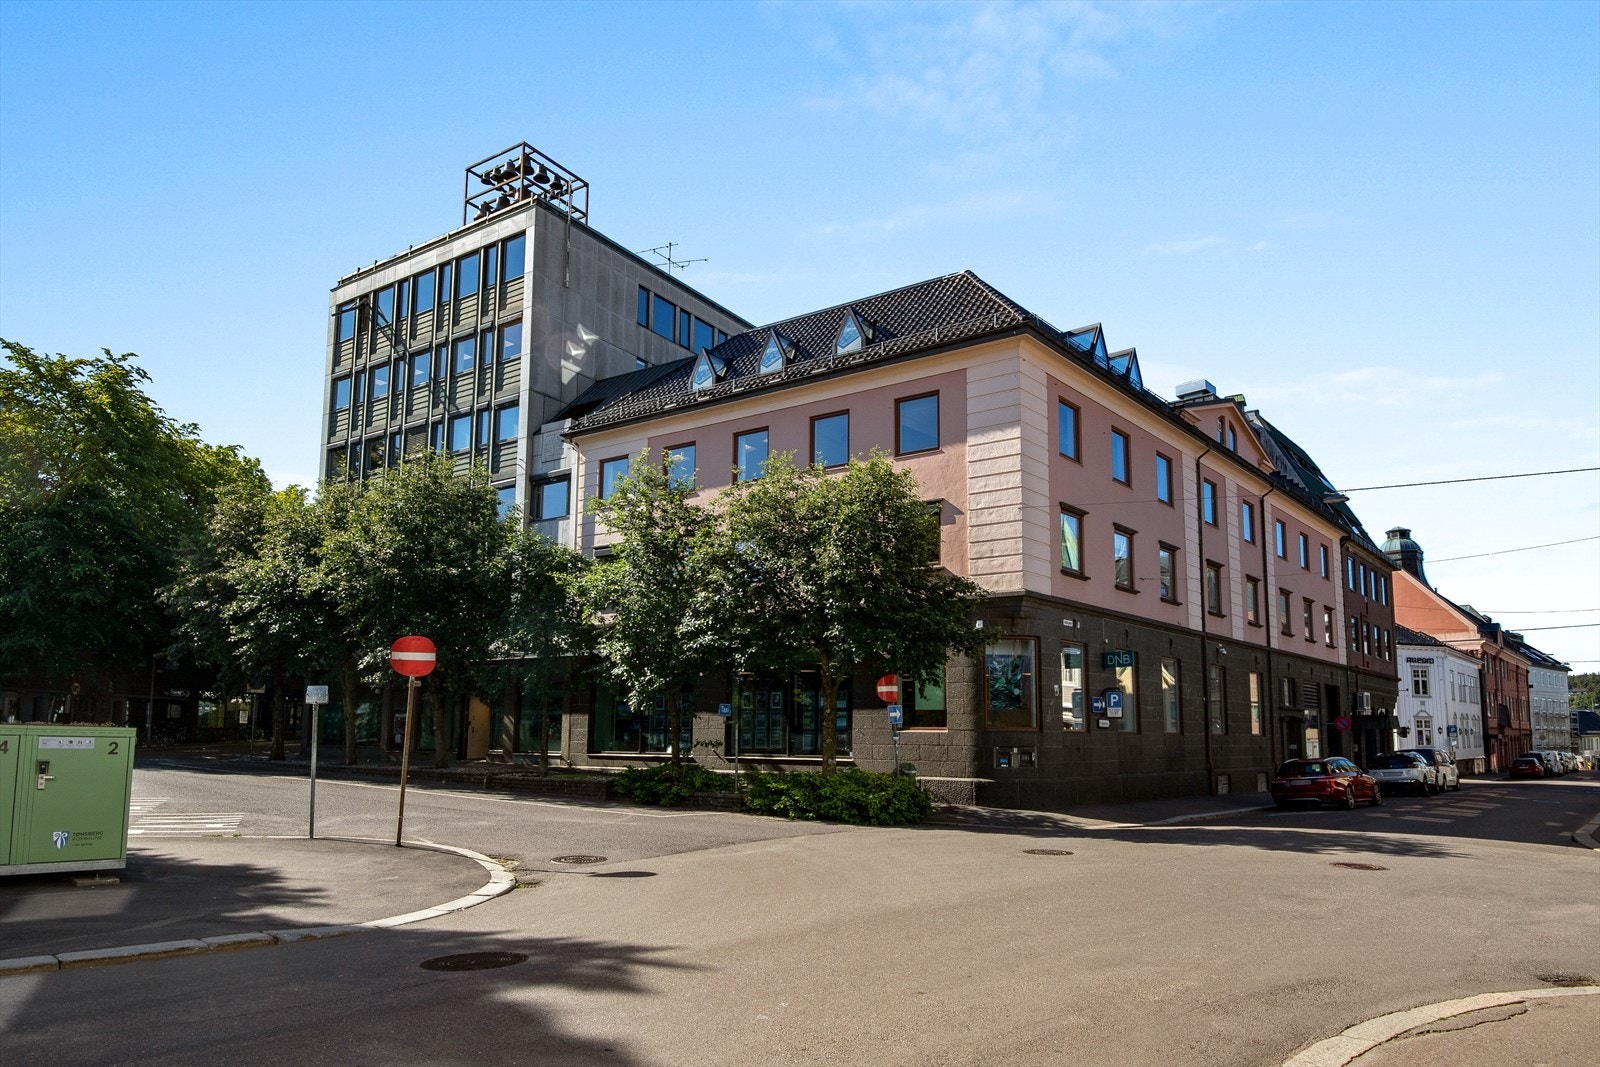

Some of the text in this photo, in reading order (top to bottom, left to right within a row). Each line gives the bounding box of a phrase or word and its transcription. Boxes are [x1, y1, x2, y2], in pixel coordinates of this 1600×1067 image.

[1107, 654, 1131, 665] DNB
[1110, 694, 1119, 707] P
[0, 740, 9, 754] 4
[107, 741, 119, 755] 2
